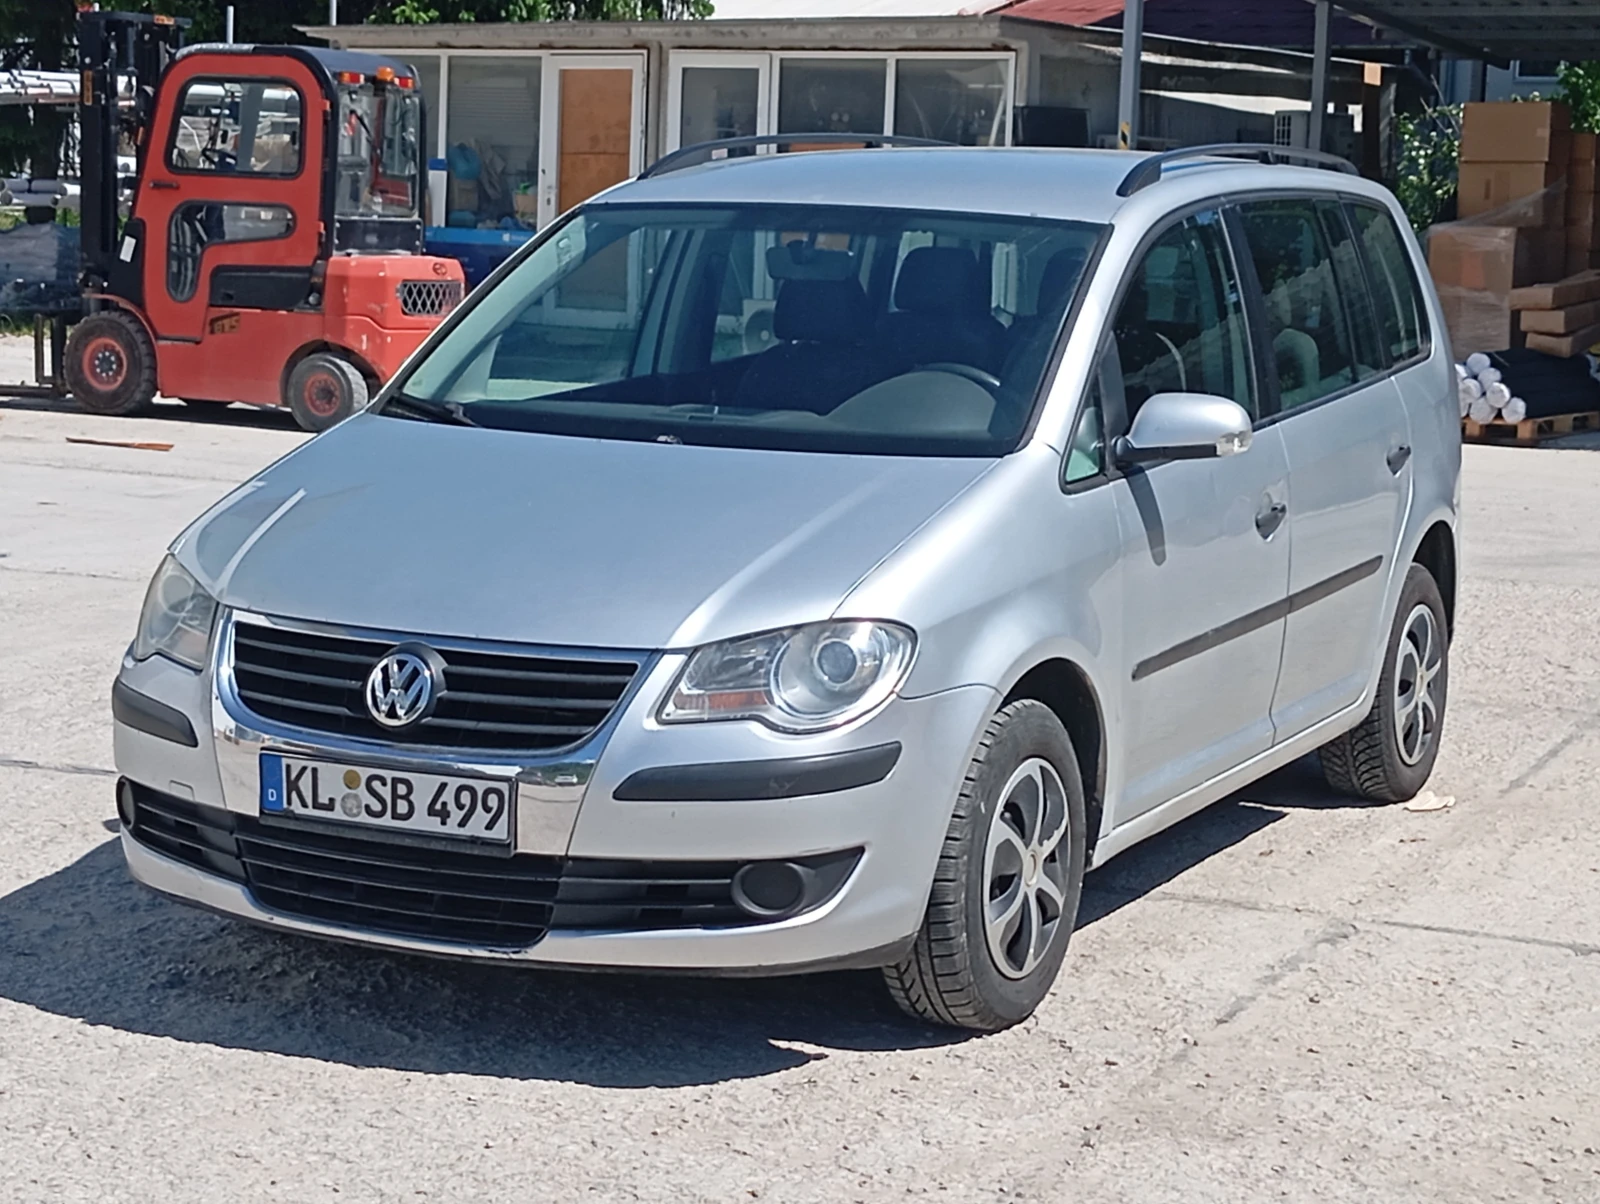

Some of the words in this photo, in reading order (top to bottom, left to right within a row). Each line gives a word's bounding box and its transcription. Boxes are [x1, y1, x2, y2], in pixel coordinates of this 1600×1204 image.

[367, 653, 431, 726] VW
[268, 788, 277, 801] D
[285, 763, 336, 812] KL
[364, 774, 416, 821] SB
[427, 781, 506, 831] 499
